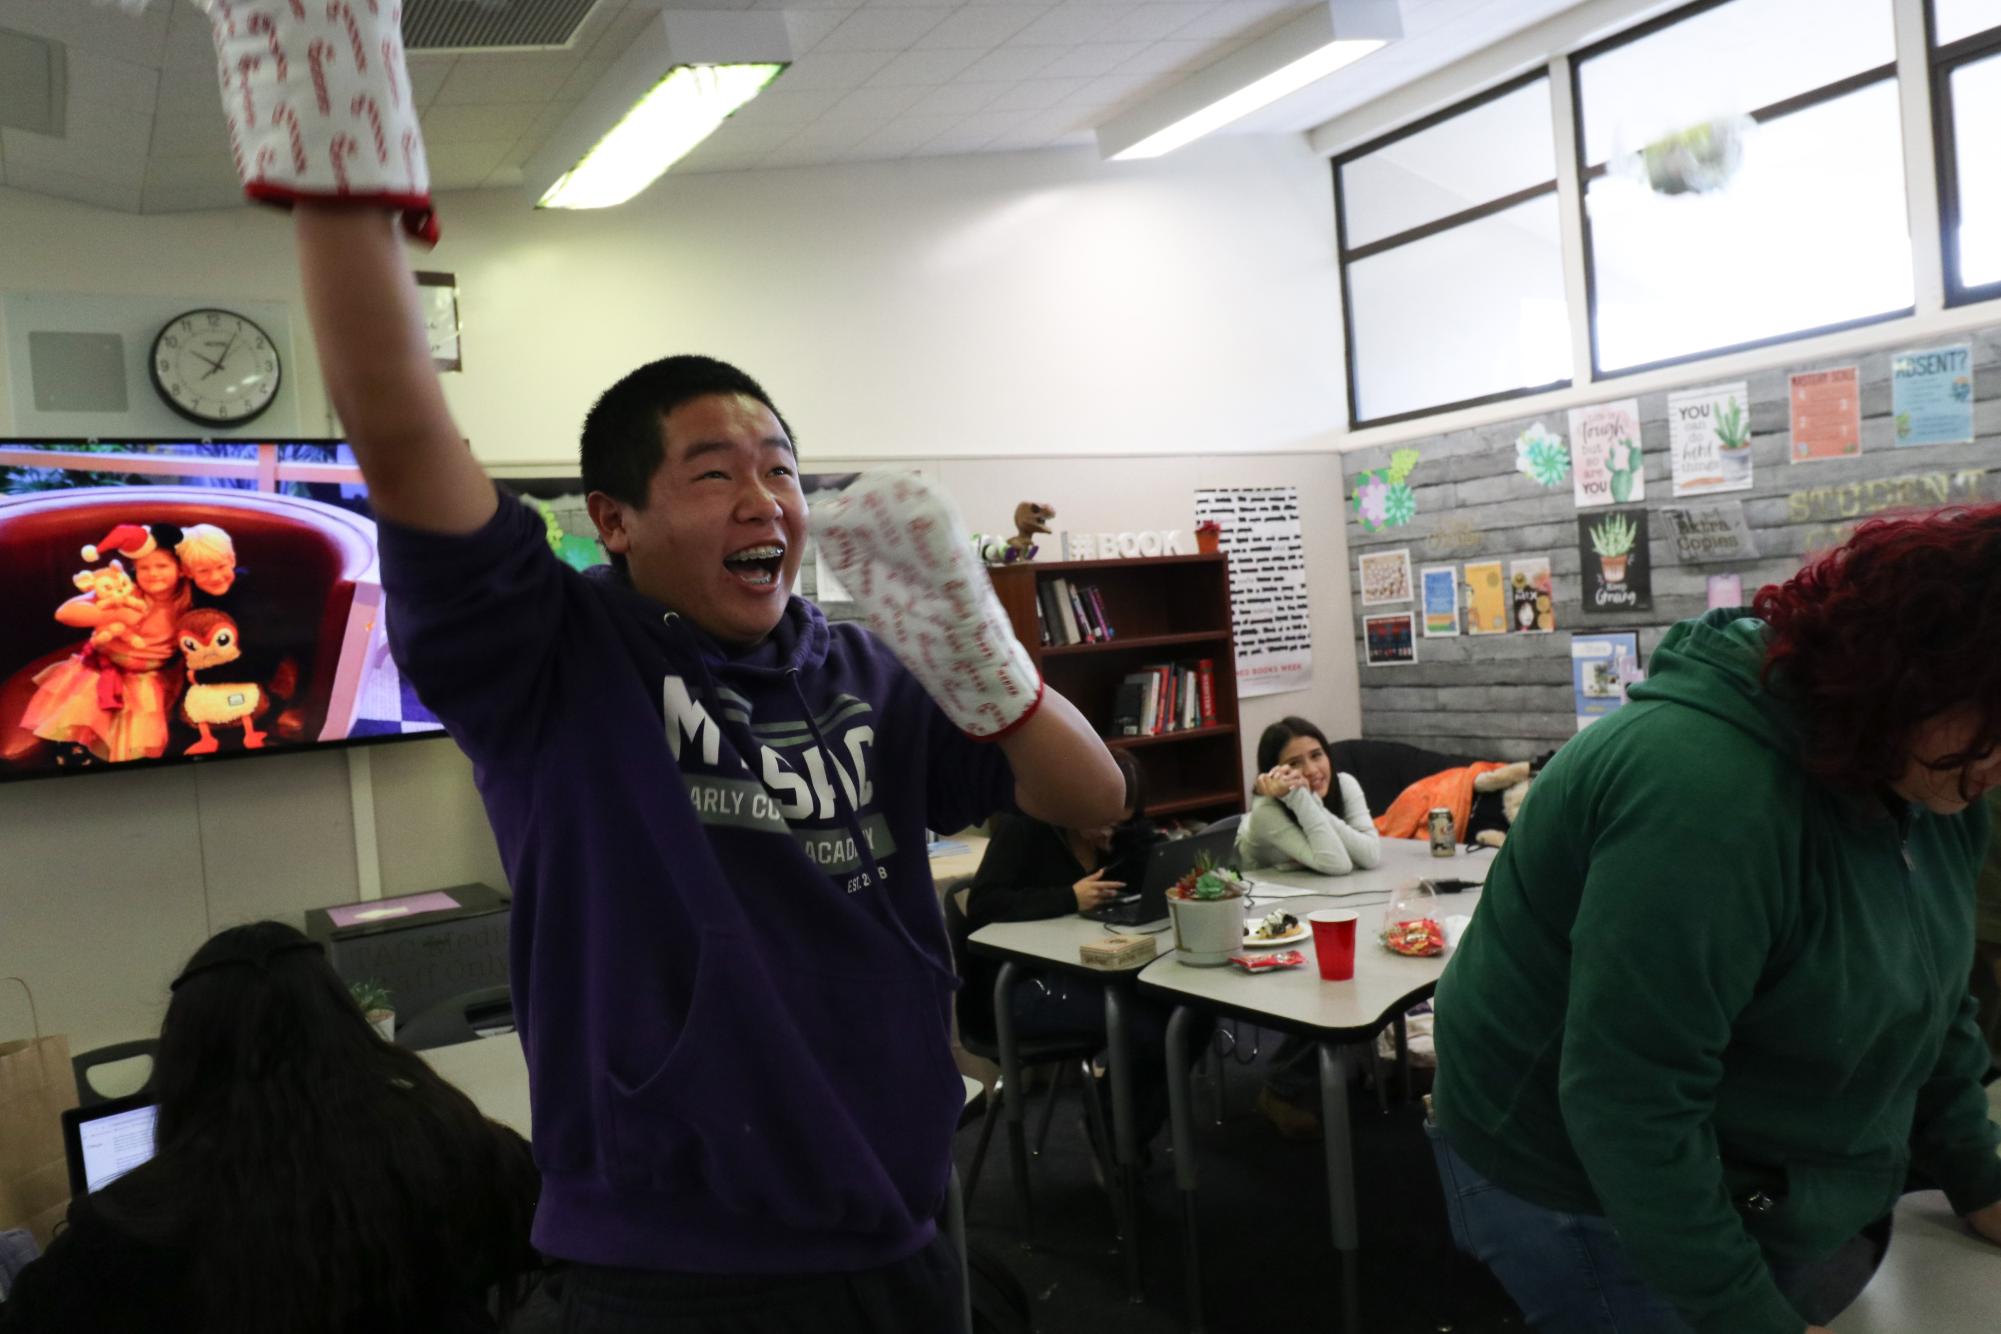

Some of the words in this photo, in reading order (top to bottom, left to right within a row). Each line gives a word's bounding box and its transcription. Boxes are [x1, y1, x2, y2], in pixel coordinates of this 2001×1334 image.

[1679, 403, 1710, 421] YOU
[1689, 432, 1704, 443] do
[1582, 480, 1607, 495] YOU
[1281, 662, 1303, 672] WEEK
[689, 785, 745, 816] ARLY
